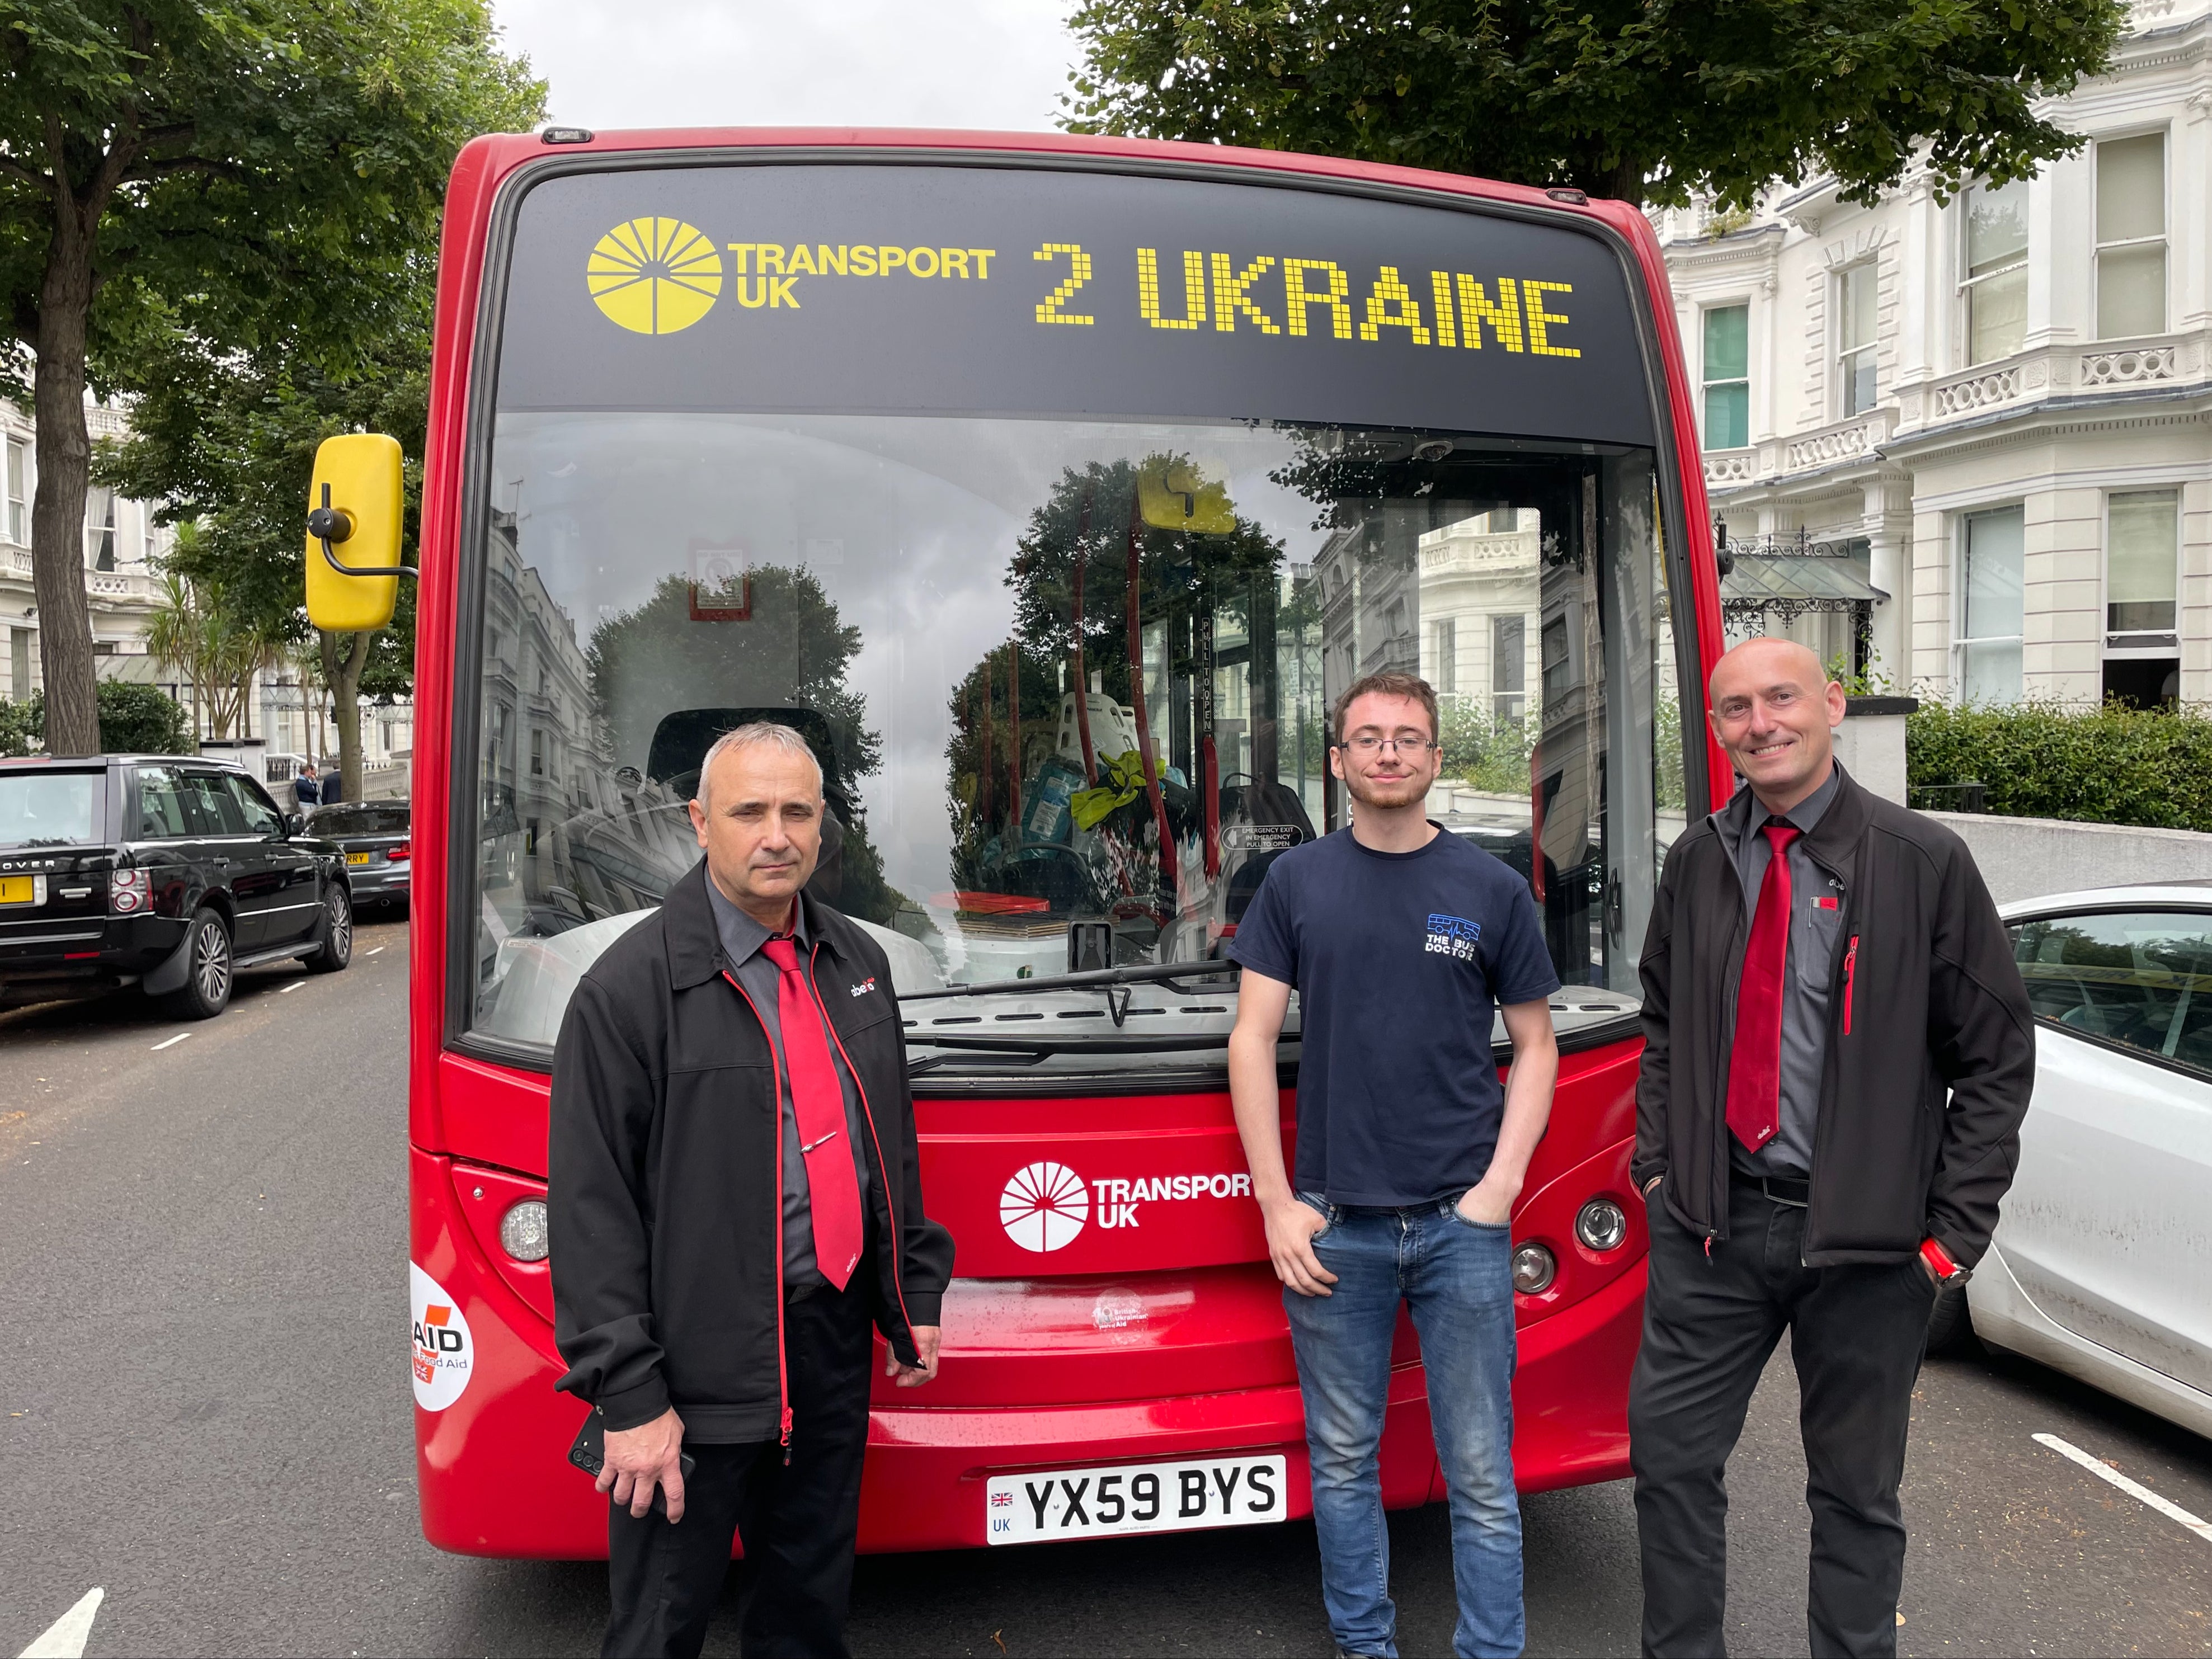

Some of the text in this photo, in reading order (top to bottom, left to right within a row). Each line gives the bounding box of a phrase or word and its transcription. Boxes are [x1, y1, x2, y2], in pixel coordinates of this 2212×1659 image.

[727, 243, 995, 279] TRANSPORT
[737, 276, 801, 308] UK
[1033, 243, 1581, 358] 2 UKRAINE
[1204, 667, 1210, 686] TO
[1425, 942, 1474, 961] DOCTOR
[1427, 934, 1476, 952] THE BUS
[1092, 1173, 1253, 1203] TRANSPOR
[1097, 1203, 1140, 1229] UK
[414, 1321, 463, 1352] AID
[420, 1353, 443, 1366] Food
[446, 1359, 467, 1368] Aid
[1024, 1464, 1275, 1529] YX59 BYS
[993, 1518, 1011, 1531] UK
